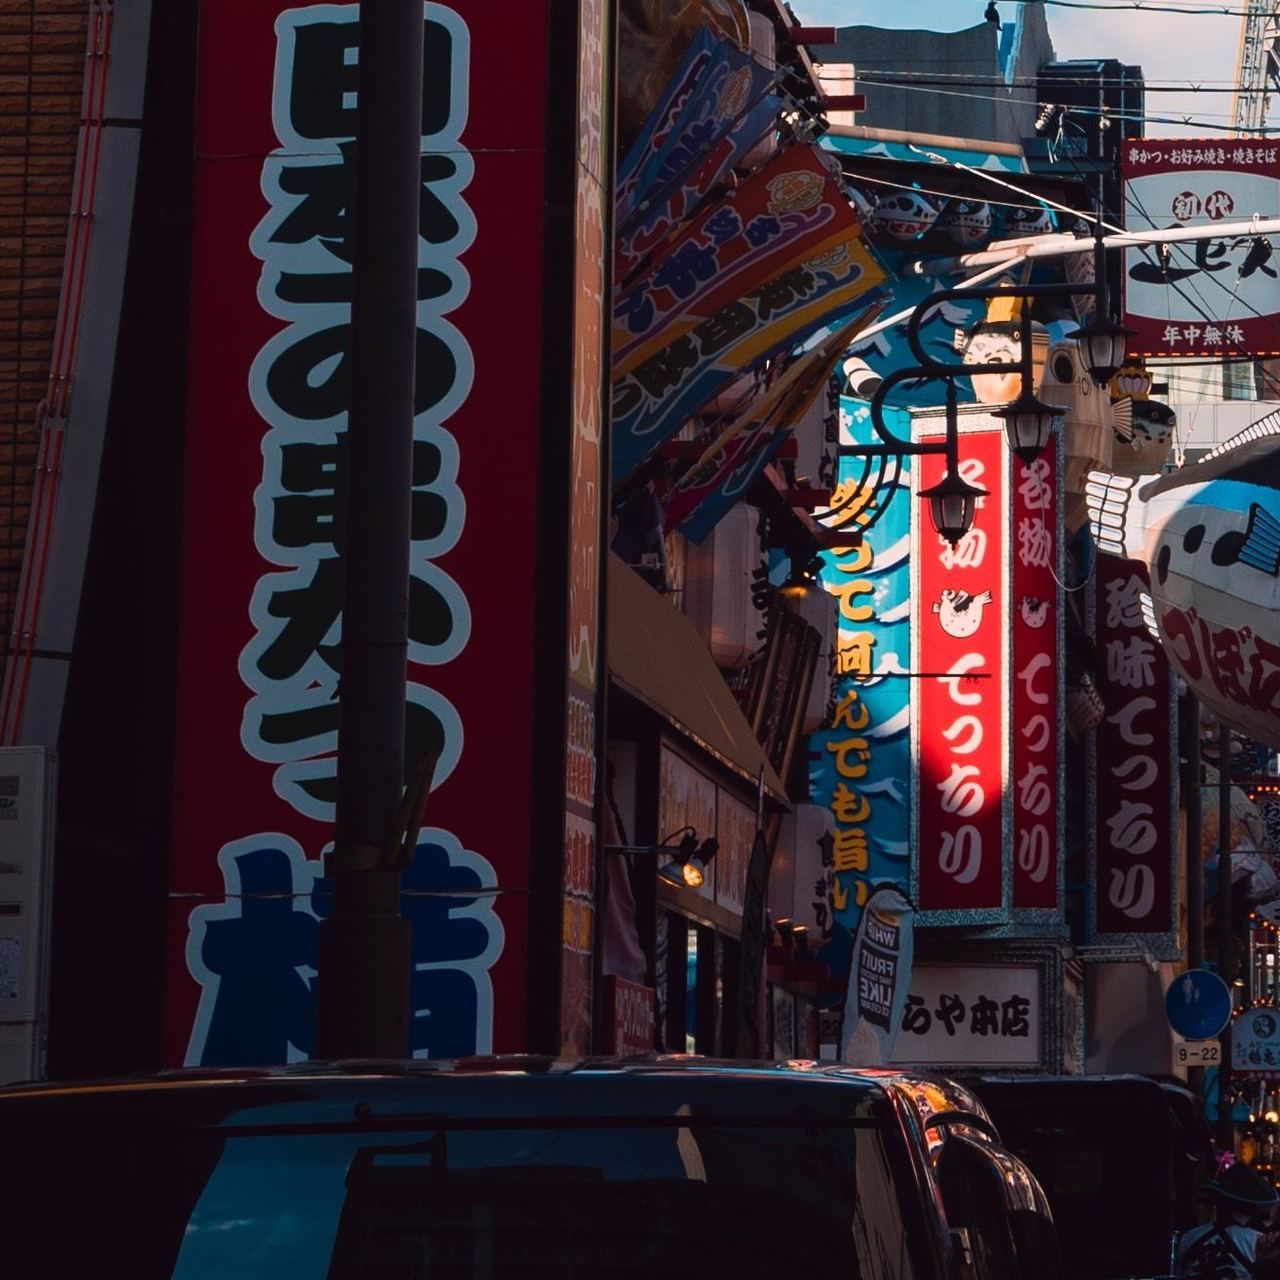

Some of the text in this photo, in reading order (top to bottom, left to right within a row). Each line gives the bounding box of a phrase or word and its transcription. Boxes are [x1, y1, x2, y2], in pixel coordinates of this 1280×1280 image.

[1172, 191, 1234, 221] 初代
[1161, 325, 1245, 346] 年中無休
[936, 653, 987, 886] てっちり
[1016, 653, 1052, 883] てっちり
[903, 992, 1031, 1039] らや本店
